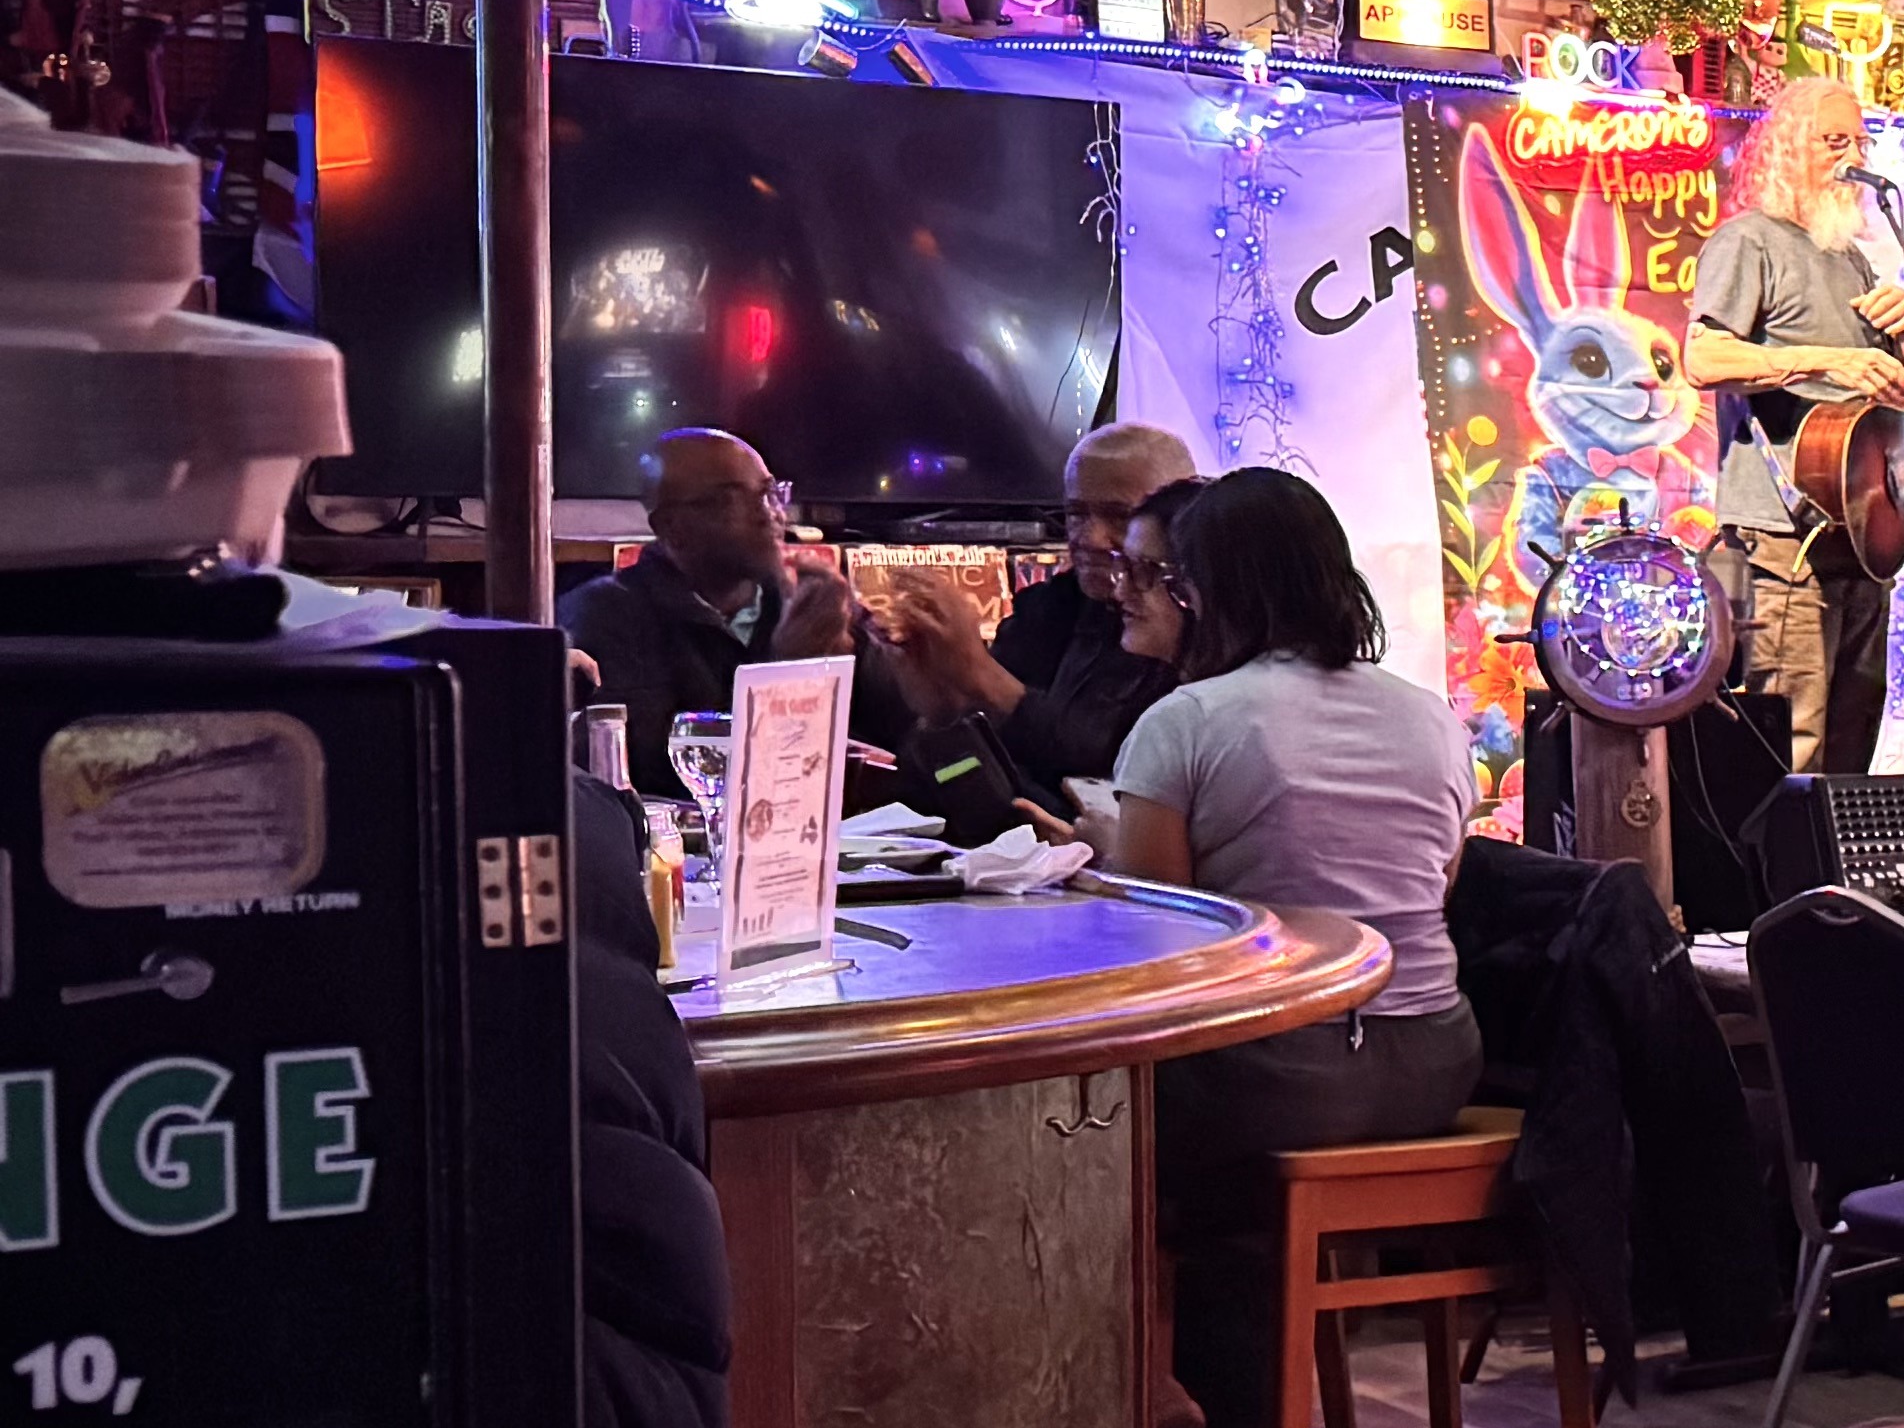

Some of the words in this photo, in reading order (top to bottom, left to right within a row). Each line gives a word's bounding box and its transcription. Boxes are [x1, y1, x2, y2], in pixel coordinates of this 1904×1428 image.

[1365, 4, 1486, 33] APUSE
[1525, 32, 1641, 89] ROCK
[1598, 158, 1718, 227] Happy
[261, 891, 361, 917] RETURN
[14, 1333, 142, 1415] 10,
